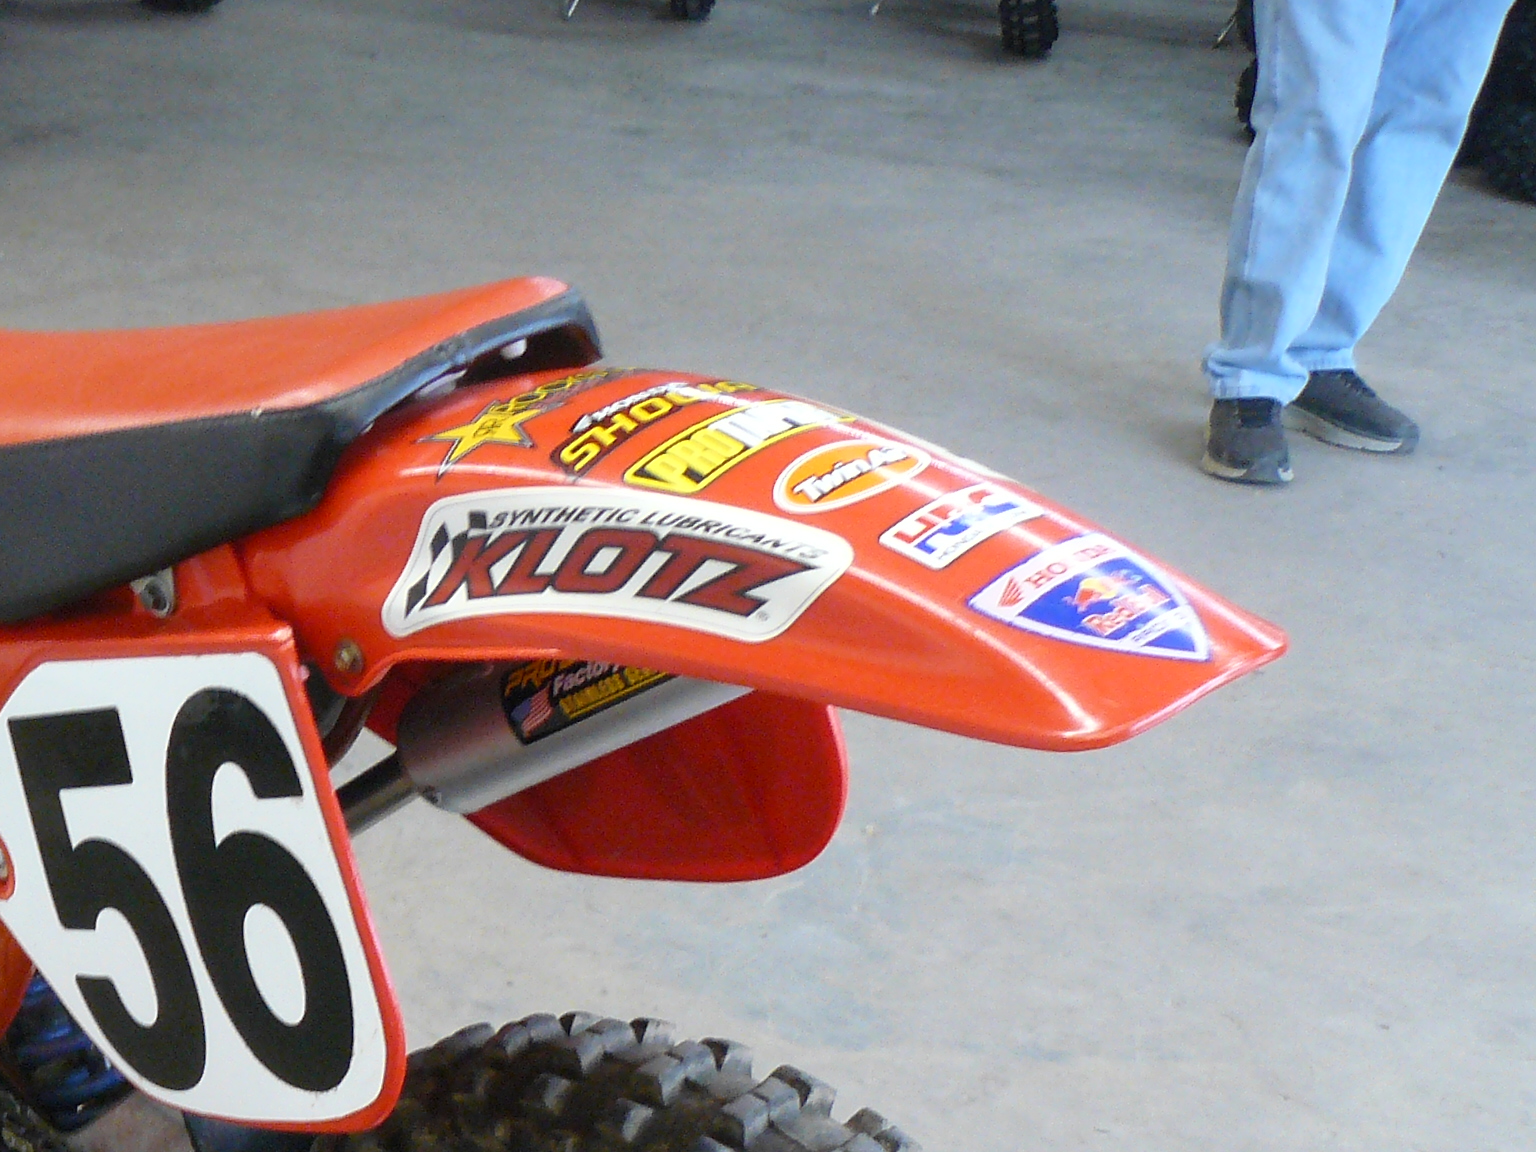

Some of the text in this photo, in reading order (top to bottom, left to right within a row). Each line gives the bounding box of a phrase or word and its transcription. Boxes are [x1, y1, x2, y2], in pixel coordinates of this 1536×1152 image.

[489, 504, 829, 558] SYNTHETIC LUBRICANTS
[1025, 544, 1115, 590] HODA
[419, 526, 818, 618] KLOTZ
[7, 685, 355, 1093] 56
